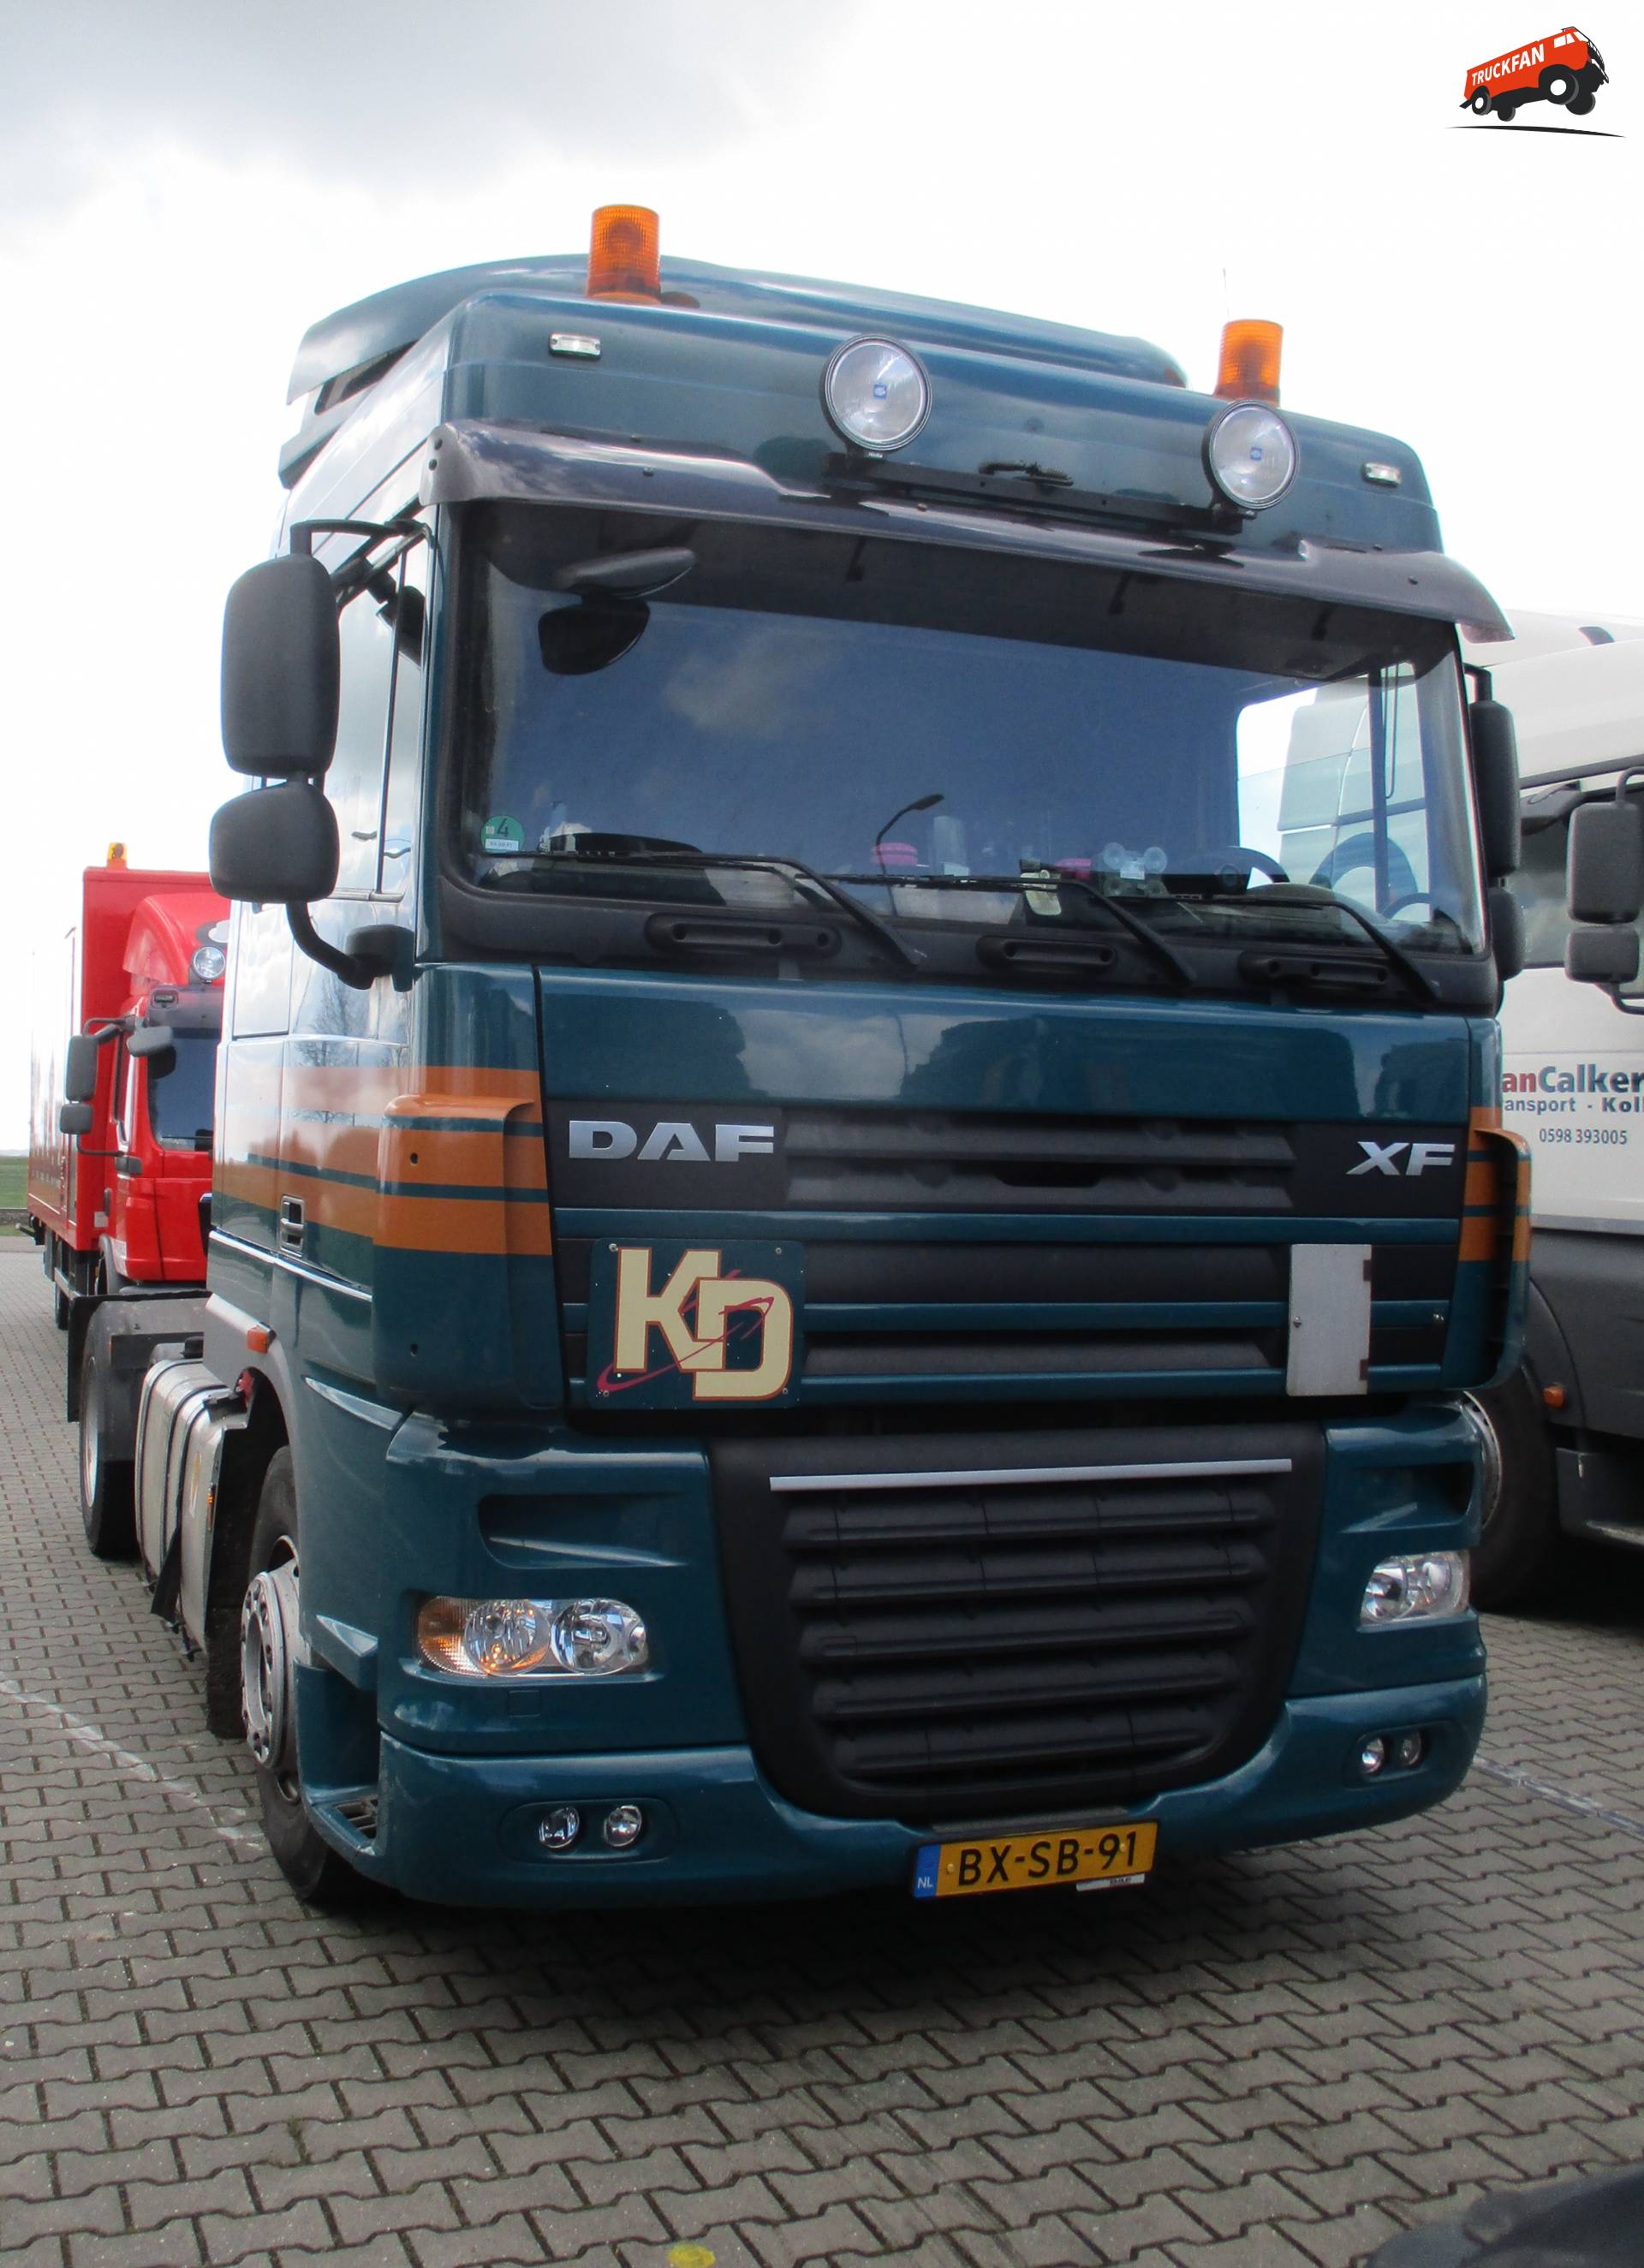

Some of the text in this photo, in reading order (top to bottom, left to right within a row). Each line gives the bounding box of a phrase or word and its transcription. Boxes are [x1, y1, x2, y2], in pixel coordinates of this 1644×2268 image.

[497, 818, 509, 837] 4
[569, 1120, 775, 1162] DAF
[1539, 1128, 1628, 1145] 0598 393005
[1345, 1141, 1456, 1176] XF
[613, 1247, 794, 1402] KD
[917, 1830, 1137, 1890] NL BX-SB-91
